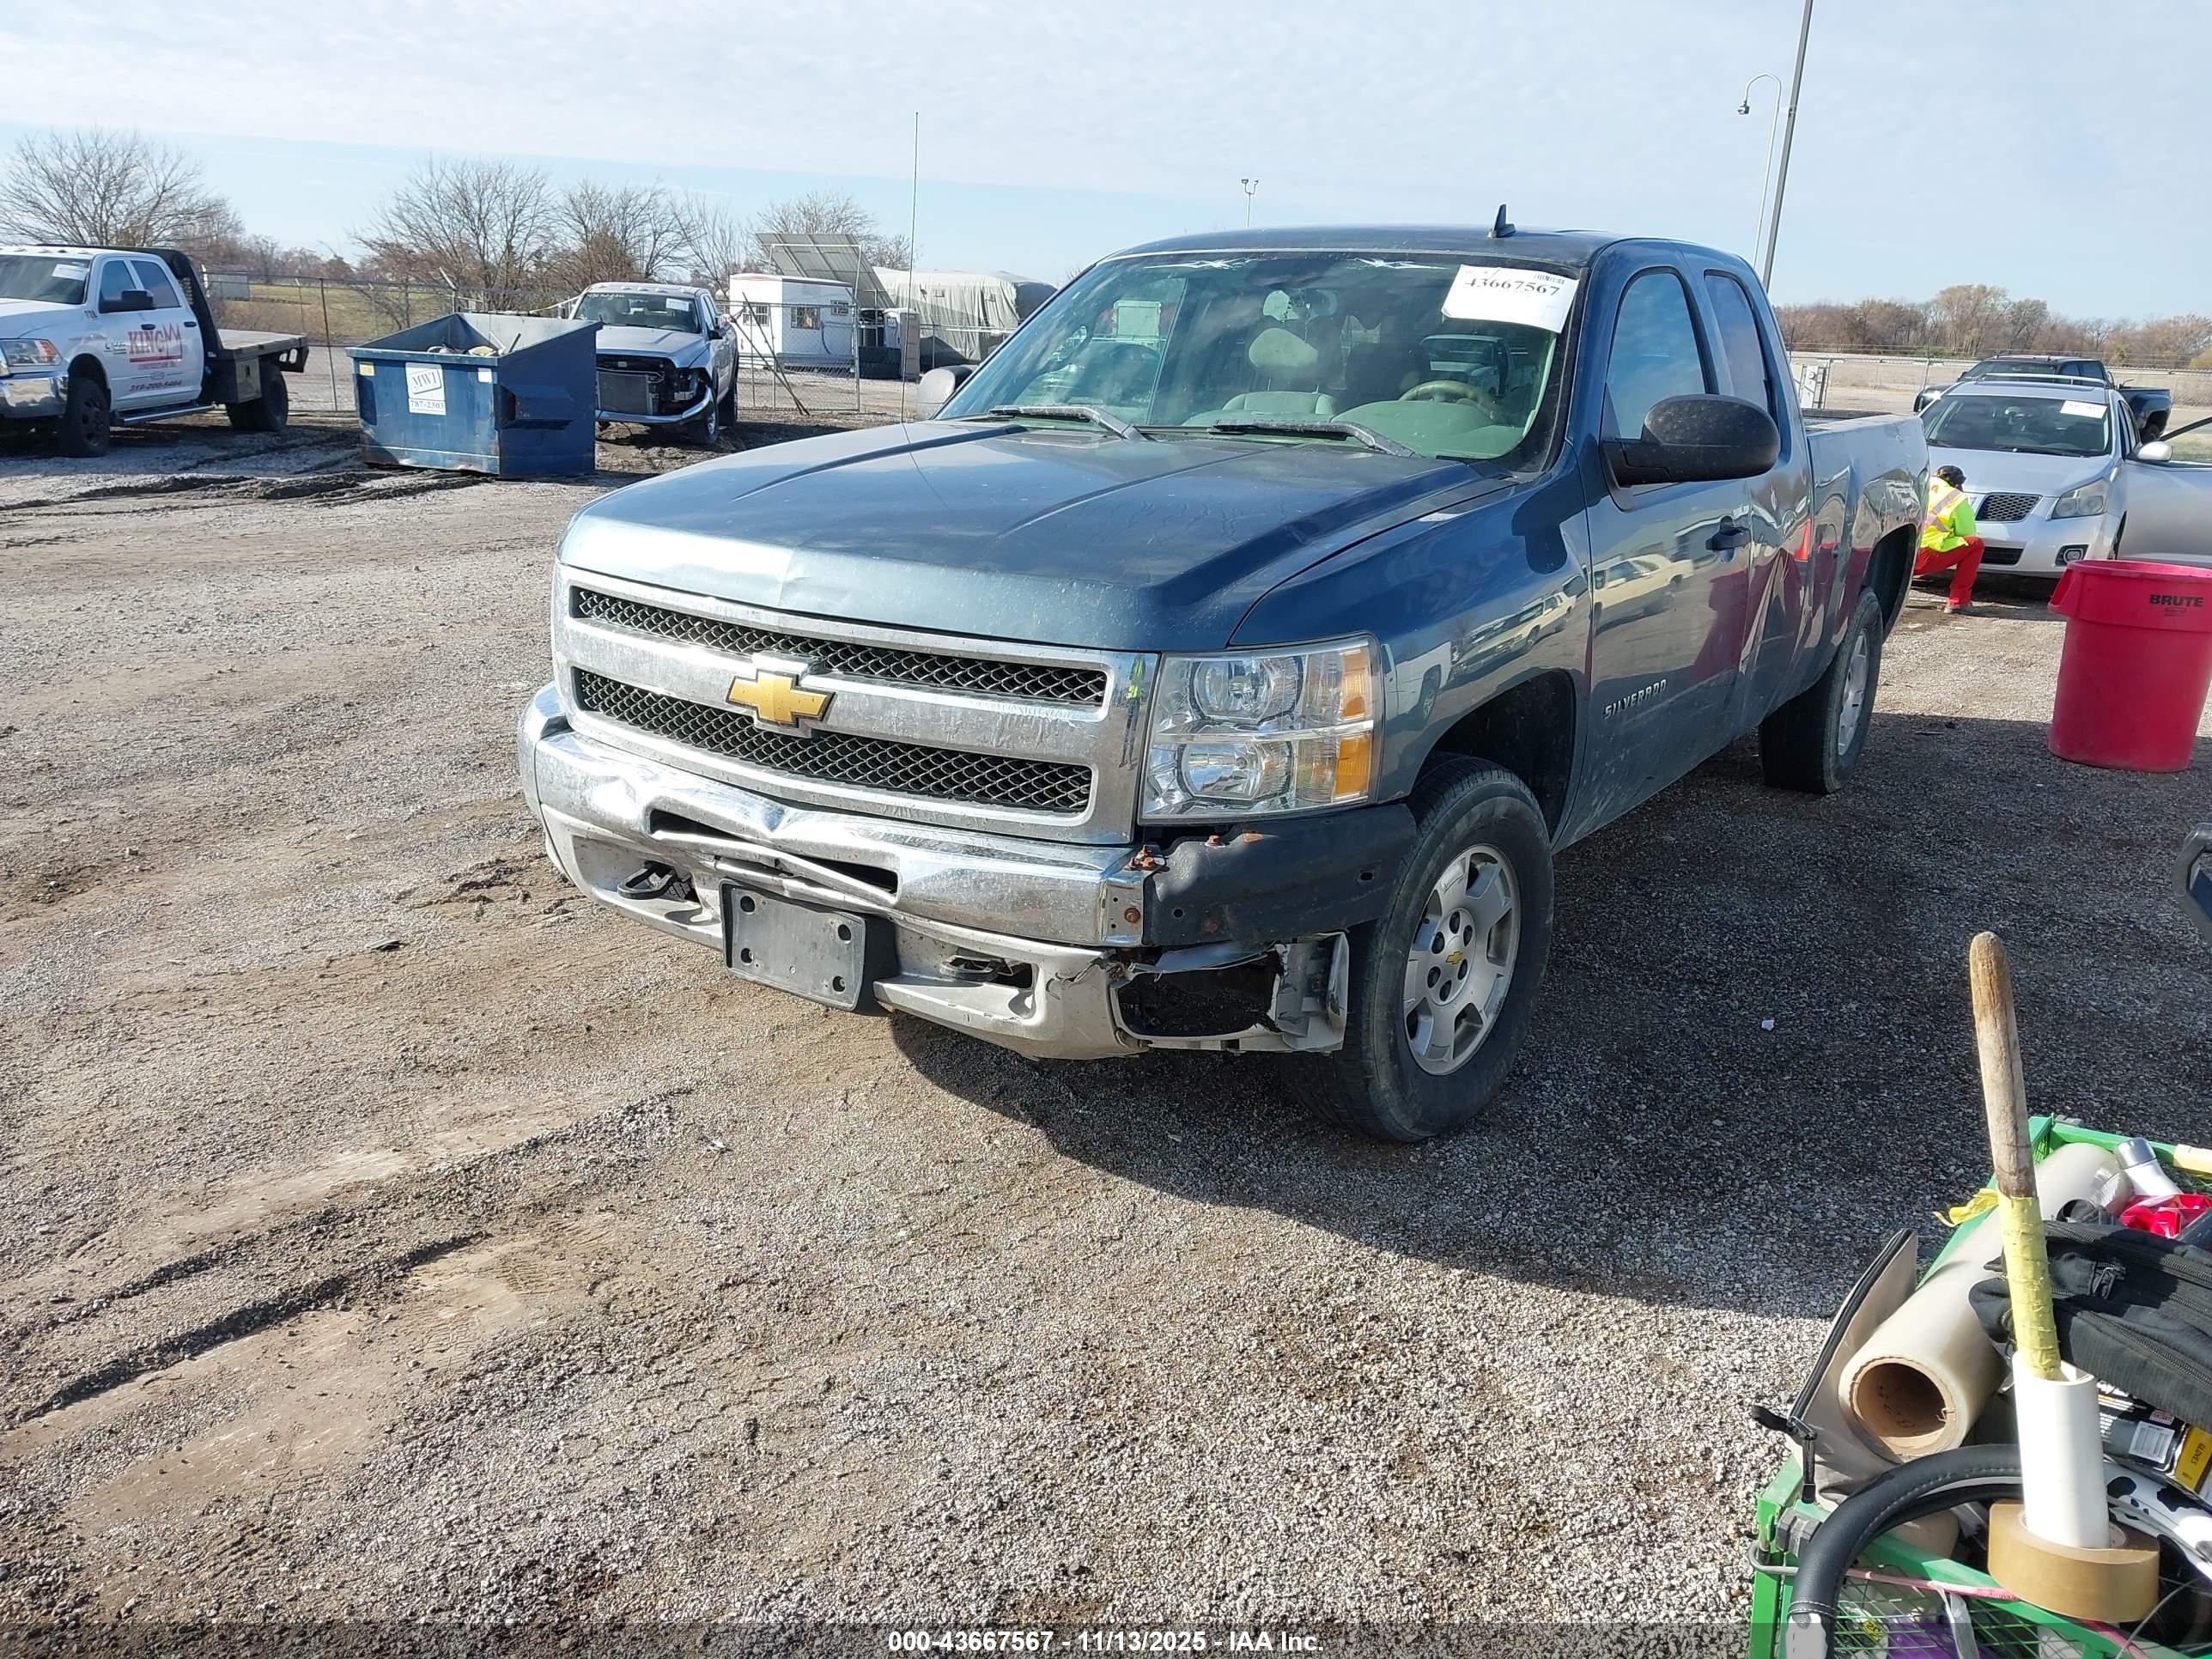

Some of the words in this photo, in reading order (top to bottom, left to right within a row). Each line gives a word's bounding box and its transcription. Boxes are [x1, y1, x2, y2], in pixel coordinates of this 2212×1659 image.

[1465, 277, 1560, 296] 43667567
[128, 330, 166, 355] KING
[413, 371, 438, 391] MWI
[410, 399, 444, 410] 787-2303
[2149, 594, 2204, 607] BRUTE
[1601, 678, 1667, 720] SILVERADO
